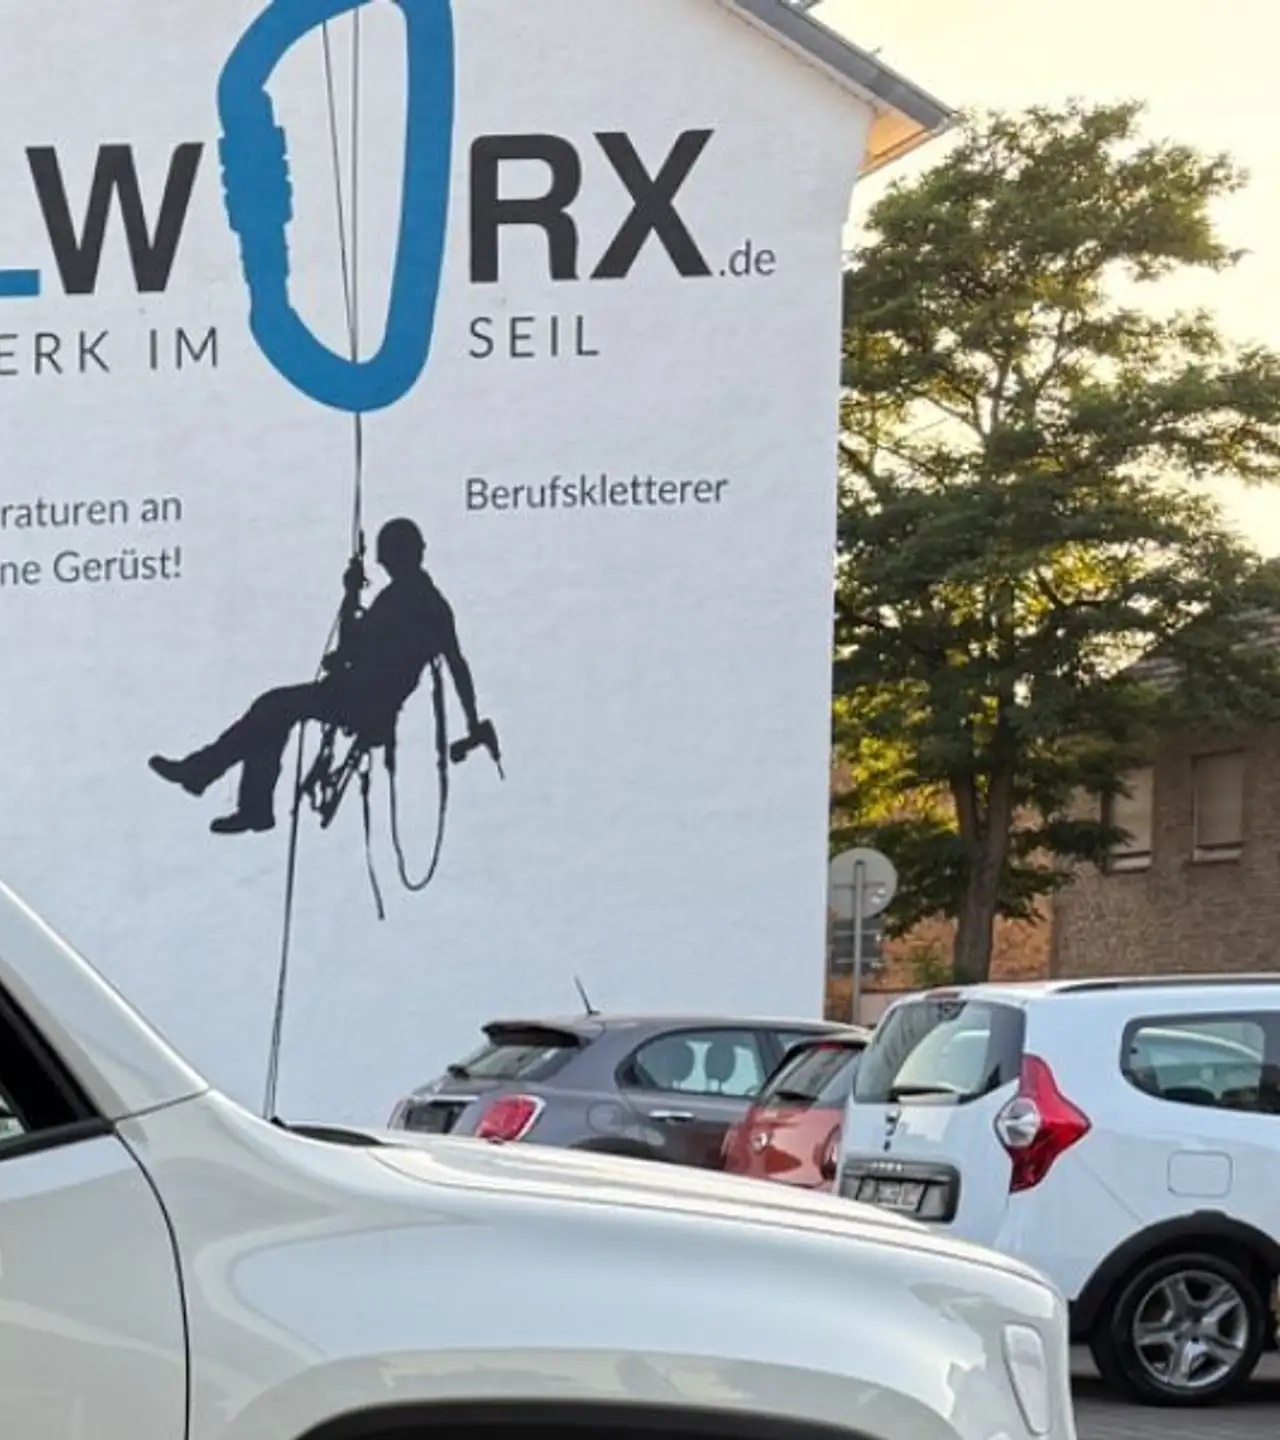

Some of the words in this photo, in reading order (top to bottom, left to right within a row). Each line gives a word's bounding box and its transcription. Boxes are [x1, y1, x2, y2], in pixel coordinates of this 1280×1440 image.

[149, 326, 220, 371] IM
[468, 314, 600, 360] SEIL
[140, 496, 183, 523] an
[465, 475, 729, 512] Berufskletterer
[52, 546, 183, 584] Gerüst!
